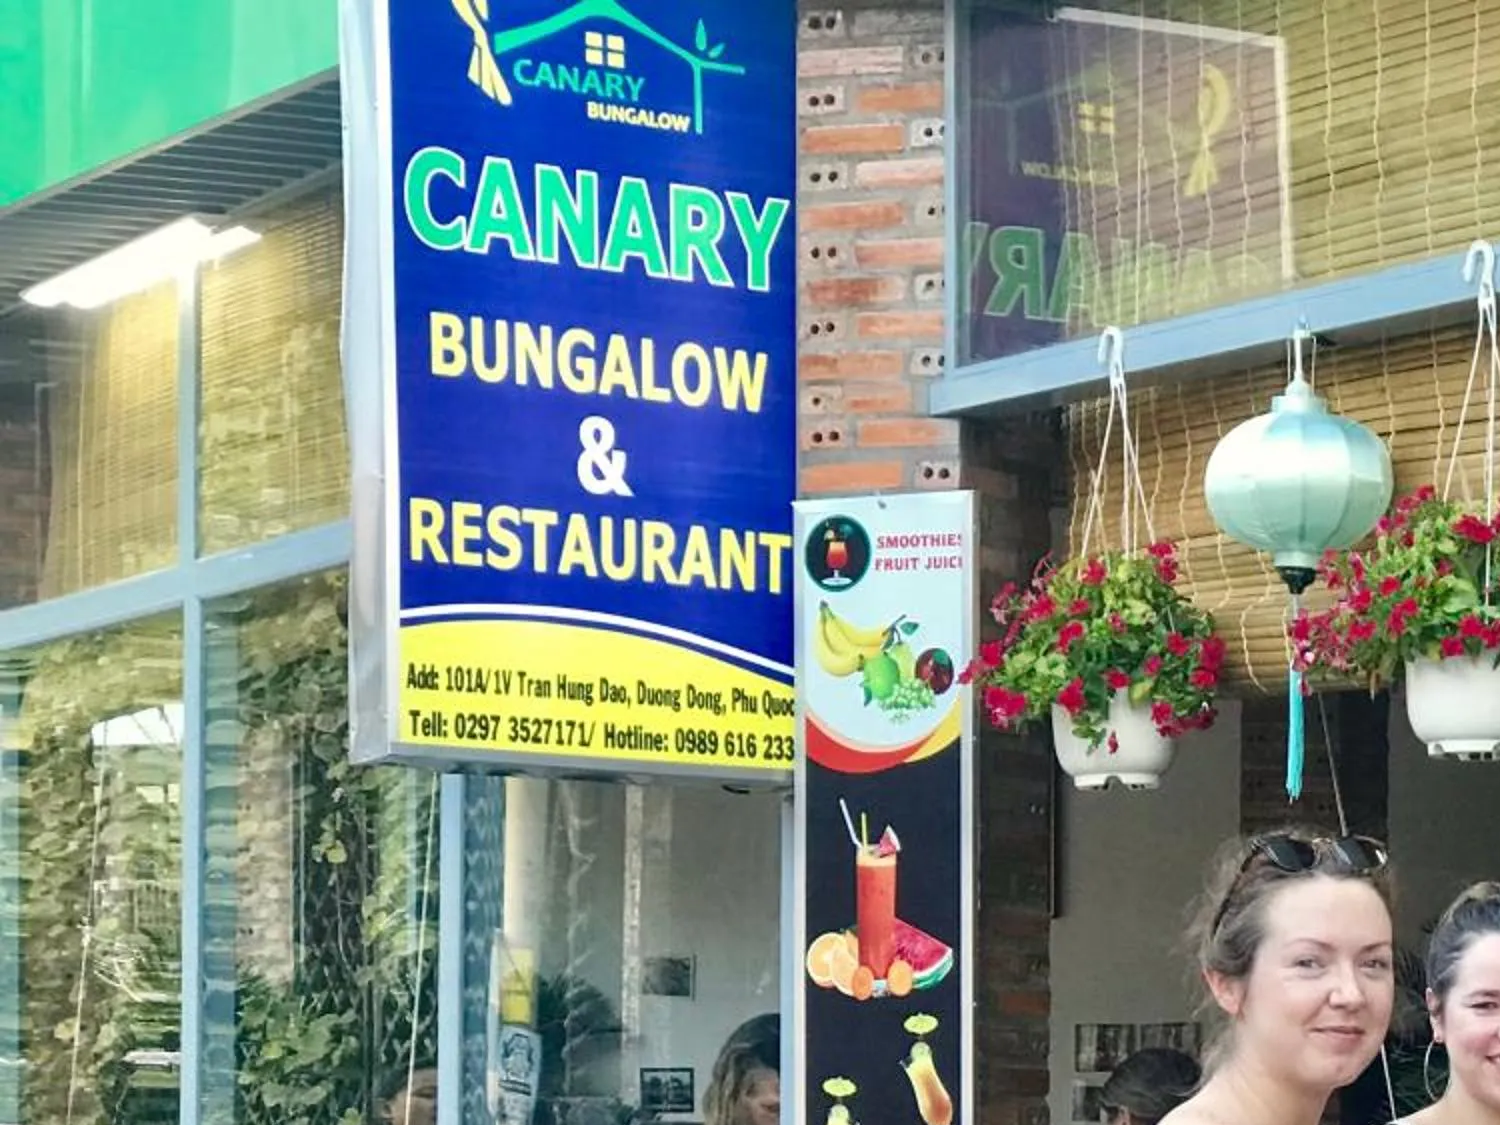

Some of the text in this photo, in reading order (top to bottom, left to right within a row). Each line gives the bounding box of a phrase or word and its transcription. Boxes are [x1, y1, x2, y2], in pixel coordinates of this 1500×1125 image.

[512, 58, 645, 102] CANARY
[586, 101, 691, 133] BUNGALOW
[403, 146, 790, 292] CANARY
[429, 311, 769, 413] BUNGALOW
[576, 415, 635, 497] &
[409, 497, 793, 594] RESTAURANT
[875, 556, 920, 571] FRUIT
[407, 662, 439, 691] Add:
[517, 671, 552, 699] Tran
[556, 673, 595, 707] Hung
[599, 676, 631, 709] Dao,
[637, 680, 682, 713] Duong
[686, 683, 727, 716] Dong,
[731, 687, 759, 714] Phu
[408, 709, 795, 761] Tell: 0297 3527171/ Hotline: 0989 616 233
